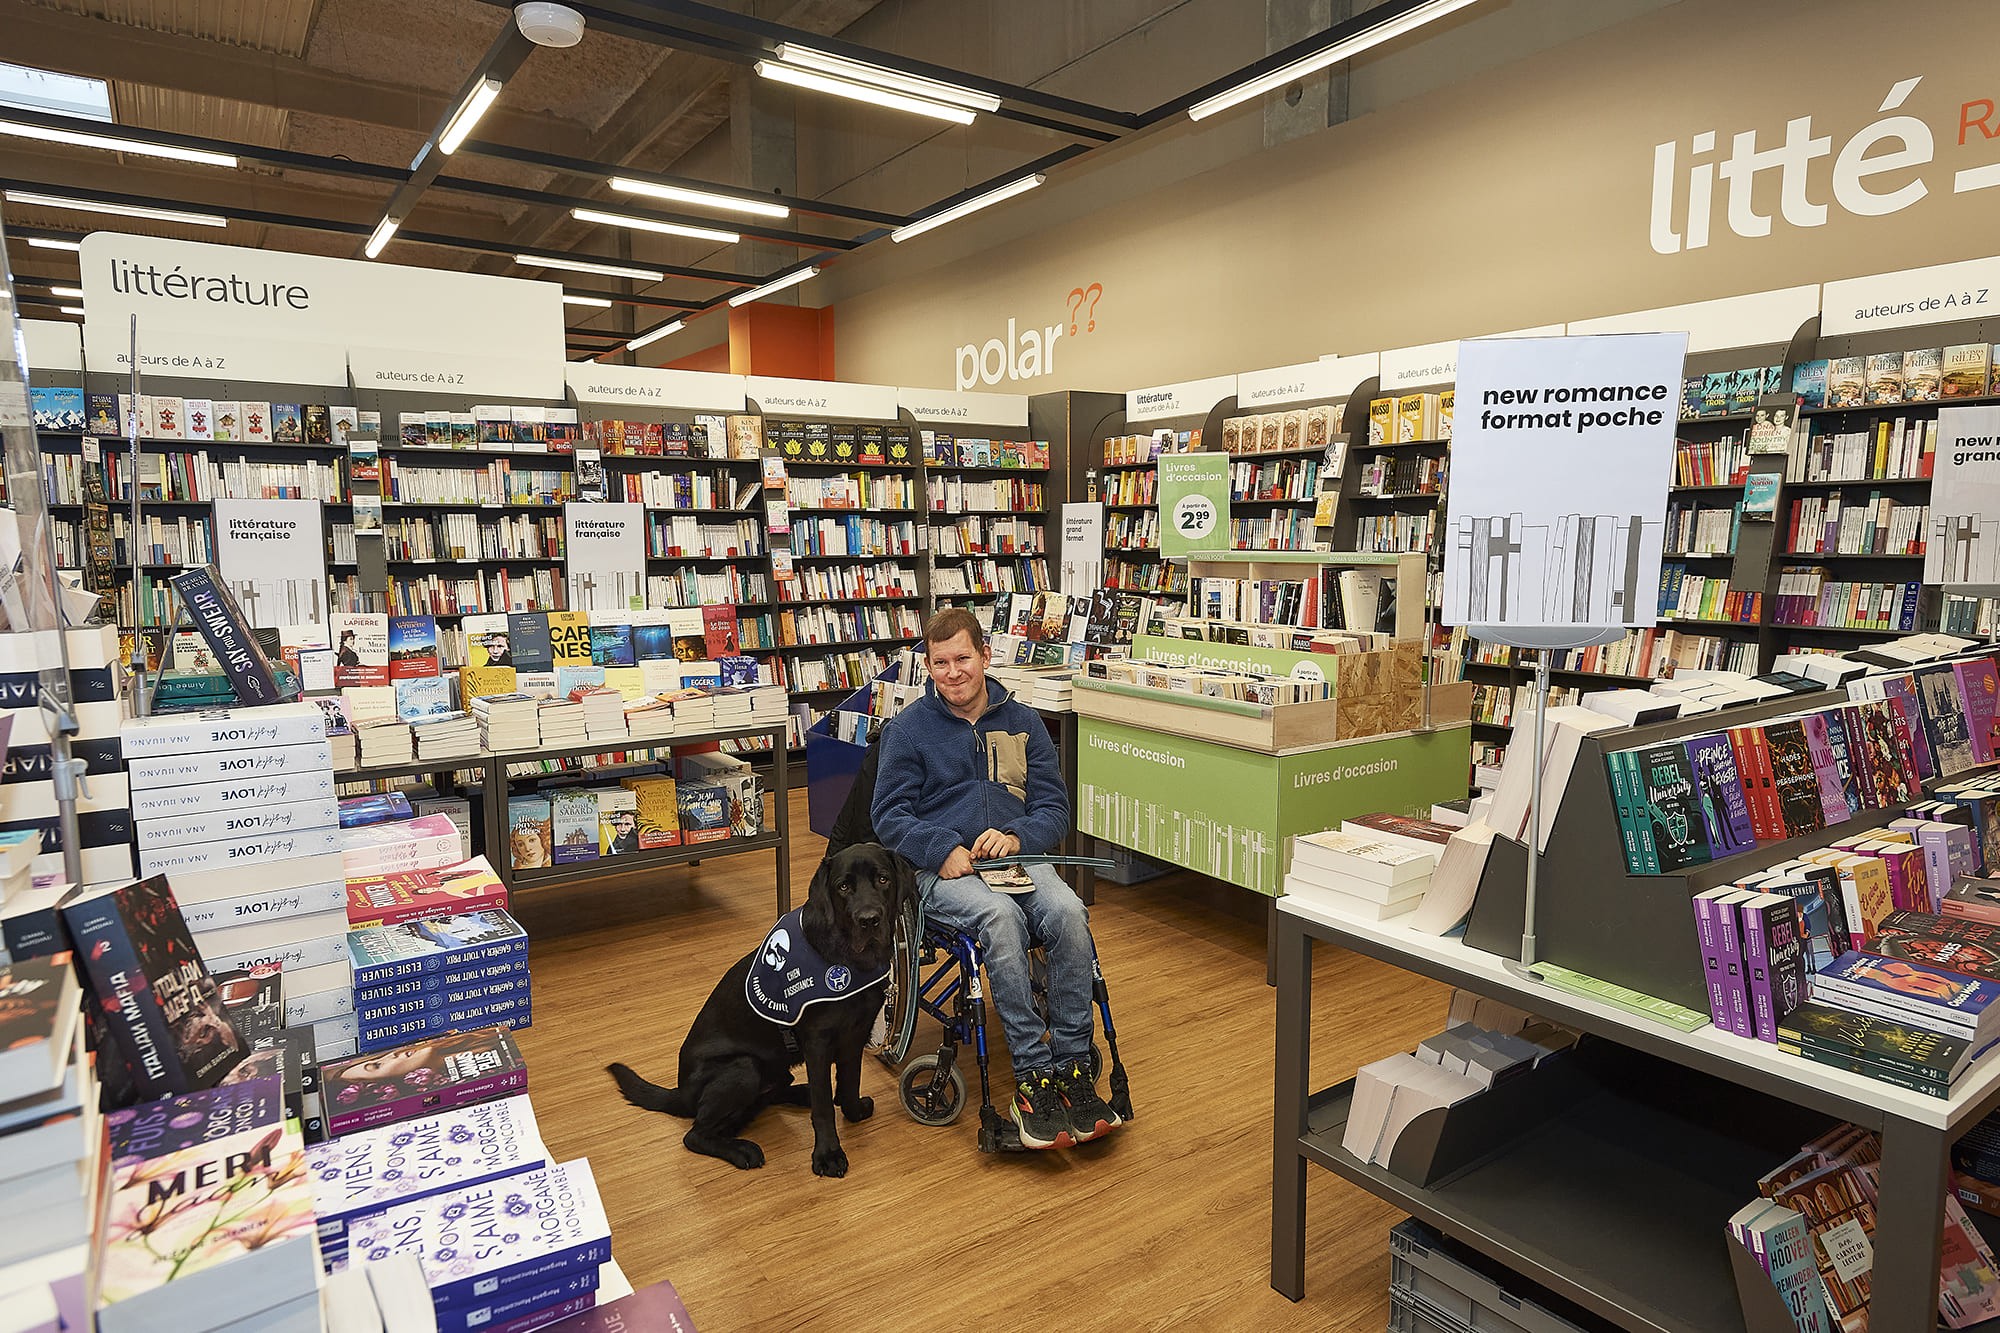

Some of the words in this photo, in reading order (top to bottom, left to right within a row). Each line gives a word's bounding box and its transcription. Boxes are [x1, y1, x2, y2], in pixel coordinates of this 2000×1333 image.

[1957, 98, 2000, 146] R
[1650, 75, 1935, 255] litté
[110, 258, 309, 310] littérature
[1854, 301, 1915, 321] auteurs
[1918, 296, 1940, 312] de
[1943, 293, 1958, 308] A
[1961, 290, 1973, 307] à
[1976, 288, 1989, 304] Z
[116, 352, 168, 367] aueurs
[172, 355, 189, 368] de
[192, 356, 203, 368] A
[205, 357, 213, 369] à
[216, 358, 225, 369] Z
[955, 317, 1063, 392] polar
[1952, 353, 1982, 362] RILEY
[1912, 359, 1940, 367] RILEY
[375, 369, 418, 383] auteurs
[420, 371, 435, 383] de
[437, 373, 447, 384] A
[447, 374, 455, 385] à
[456, 375, 465, 385] Z
[1397, 368, 1430, 380] auteurs
[1430, 365, 1443, 375] de
[1444, 363, 1451, 374] A
[587, 384, 624, 396] auteurs
[625, 386, 637, 396] de
[639, 387, 646, 397] A
[648, 387, 654, 397] à
[655, 388, 662, 398] Z
[1137, 391, 1173, 405] littérature
[1251, 388, 1277, 399] auteurs
[1277, 386, 1287, 396] de
[1287, 385, 1293, 394] A
[1300, 383, 1305, 392] Z
[1482, 387, 1538, 406] new
[1543, 384, 1668, 405] romance
[764, 396, 794, 407] auteurs
[795, 397, 806, 407] de
[807, 398, 815, 408] A
[820, 399, 827, 408] Z
[914, 406, 940, 416] auteurs
[941, 407, 950, 417] de
[951, 408, 957, 416] A
[962, 408, 968, 417] Z
[1481, 409, 1572, 430] format
[1577, 407, 1663, 434] poche
[1955, 435, 1993, 448] new
[1166, 462, 1196, 472] Livres
[229, 519, 297, 529] littérature
[575, 519, 625, 529] littérature
[1181, 512, 1195, 529] 2
[1196, 511, 1209, 520] 99
[230, 530, 291, 541] française
[575, 529, 621, 540] française
[1066, 526, 1082, 534] grand
[193, 590, 234, 639] SWEAR
[550, 626, 591, 642] CAR
[552, 642, 591, 659] NES
[1145, 646, 1185, 667] Livres
[225, 648, 253, 673] SAY
[690, 679, 715, 687] EGGERS
[1089, 734, 1120, 754] Livres
[1699, 743, 1729, 767] PRINCE
[1293, 769, 1331, 789] Livres
[1651, 763, 1682, 786] REBEL
[222, 788, 255, 800] LOVE
[1650, 778, 1692, 803] University
[141, 799, 176, 808] HUANG
[559, 809, 593, 817] SABARD
[227, 818, 261, 830] LOVE
[147, 829, 182, 838] HUANG
[229, 845, 262, 857] LOVE
[150, 859, 184, 868] HUANG
[1792, 885, 1816, 896] KENNEDY
[194, 911, 215, 921] ANA
[235, 901, 269, 917] LOVE
[1771, 921, 1794, 947] REBEL
[1770, 937, 1800, 966] University
[362, 968, 394, 981] SILVER
[397, 961, 421, 974] ELSIE
[361, 987, 393, 1000] SILVER
[396, 981, 421, 993] ELSIE
[110, 970, 143, 1023] MAFIA
[365, 1006, 396, 1020] SILVER
[400, 999, 424, 1012] ELSIE
[366, 1026, 398, 1040] SILVER
[401, 1020, 426, 1033] ELSIE
[130, 1022, 166, 1082] ITALIAN
[495, 1101, 520, 1162] MONCOMBLE
[387, 1146, 406, 1167] ON
[345, 1137, 376, 1200] VIENS,
[551, 1167, 583, 1238] MONCOMBLE
[440, 1221, 459, 1246] ON
[1774, 1225, 1799, 1245] COLLEEN
[1771, 1236, 1810, 1271] HOOVER
[1836, 1245, 1856, 1260] CARNET
[1842, 1251, 1865, 1267] LECTURE
[539, 1260, 568, 1272] Morgane
[1776, 1265, 1816, 1292] REMINDERS
[1791, 1286, 1807, 1317] OF
